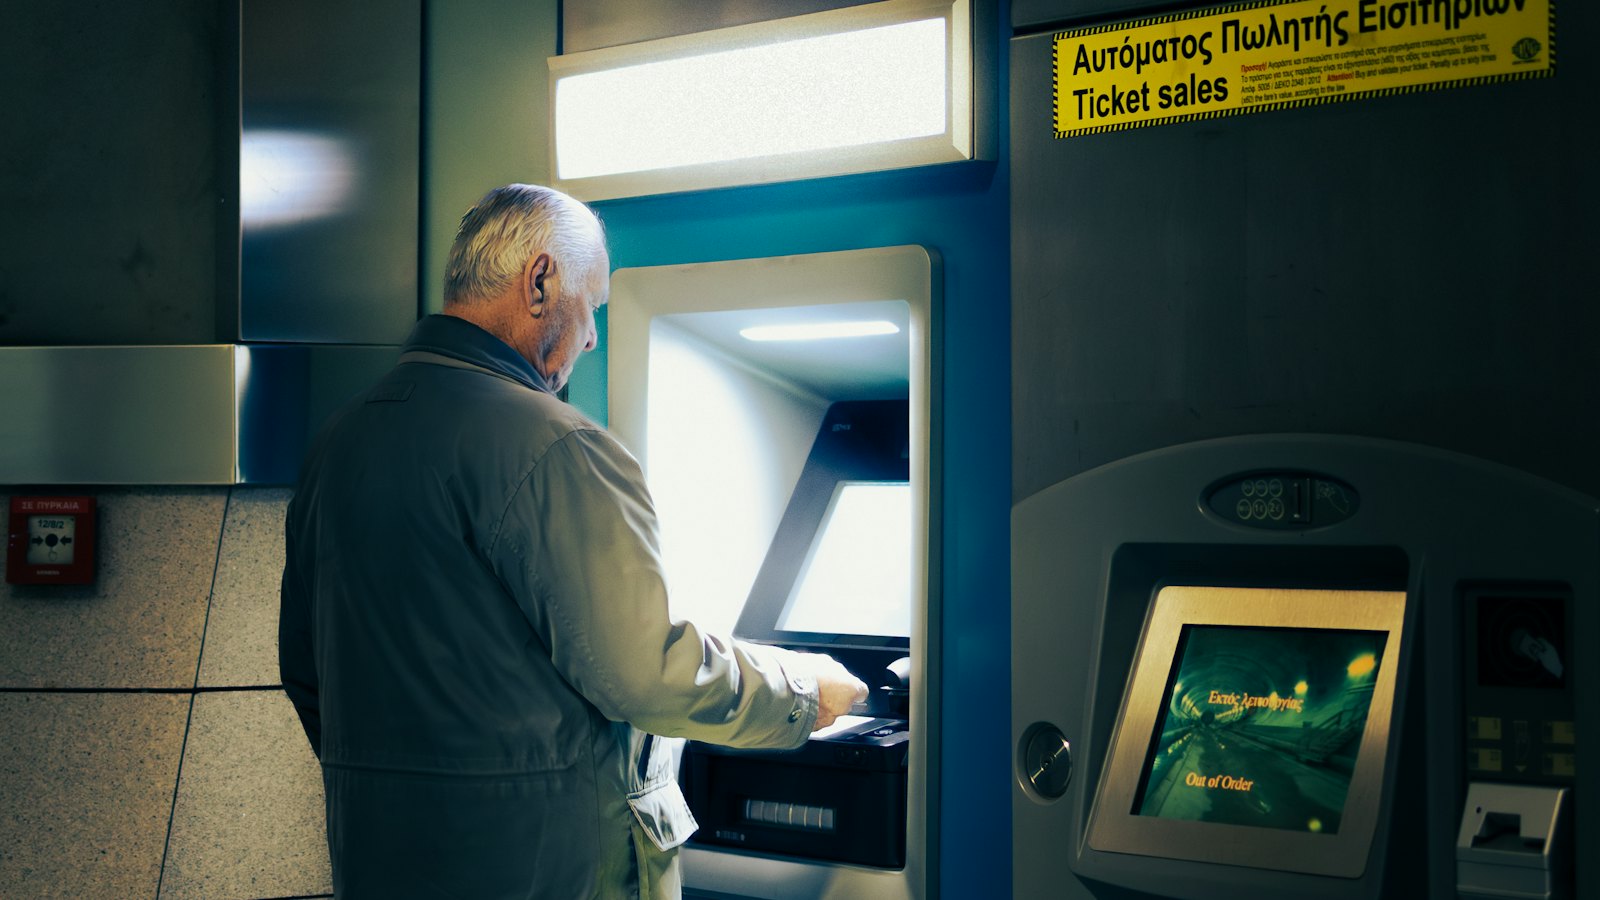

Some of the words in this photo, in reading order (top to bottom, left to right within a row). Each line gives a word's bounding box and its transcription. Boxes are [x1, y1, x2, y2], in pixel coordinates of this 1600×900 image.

[1073, 31, 1212, 75] Αυτόματος
[1222, 6, 1348, 53] Πωλητής
[1241, 62, 1267, 74] Προσοχή!
[1308, 76, 1321, 84] 2012
[1327, 71, 1354, 81] Attention!
[1355, 70, 1366, 79] Buy
[1073, 81, 1150, 120] Ticket
[1158, 74, 1228, 109] sales
[22, 501, 33, 510] ΣΕ
[37, 501, 79, 510] ΠΥΡΚΑΙΑ
[38, 519, 64, 529] 12/8/2
[1208, 691, 1240, 709] Εκτός
[1186, 772, 1206, 787] Out
[1208, 774, 1222, 788] of
[1222, 775, 1253, 791] Order
